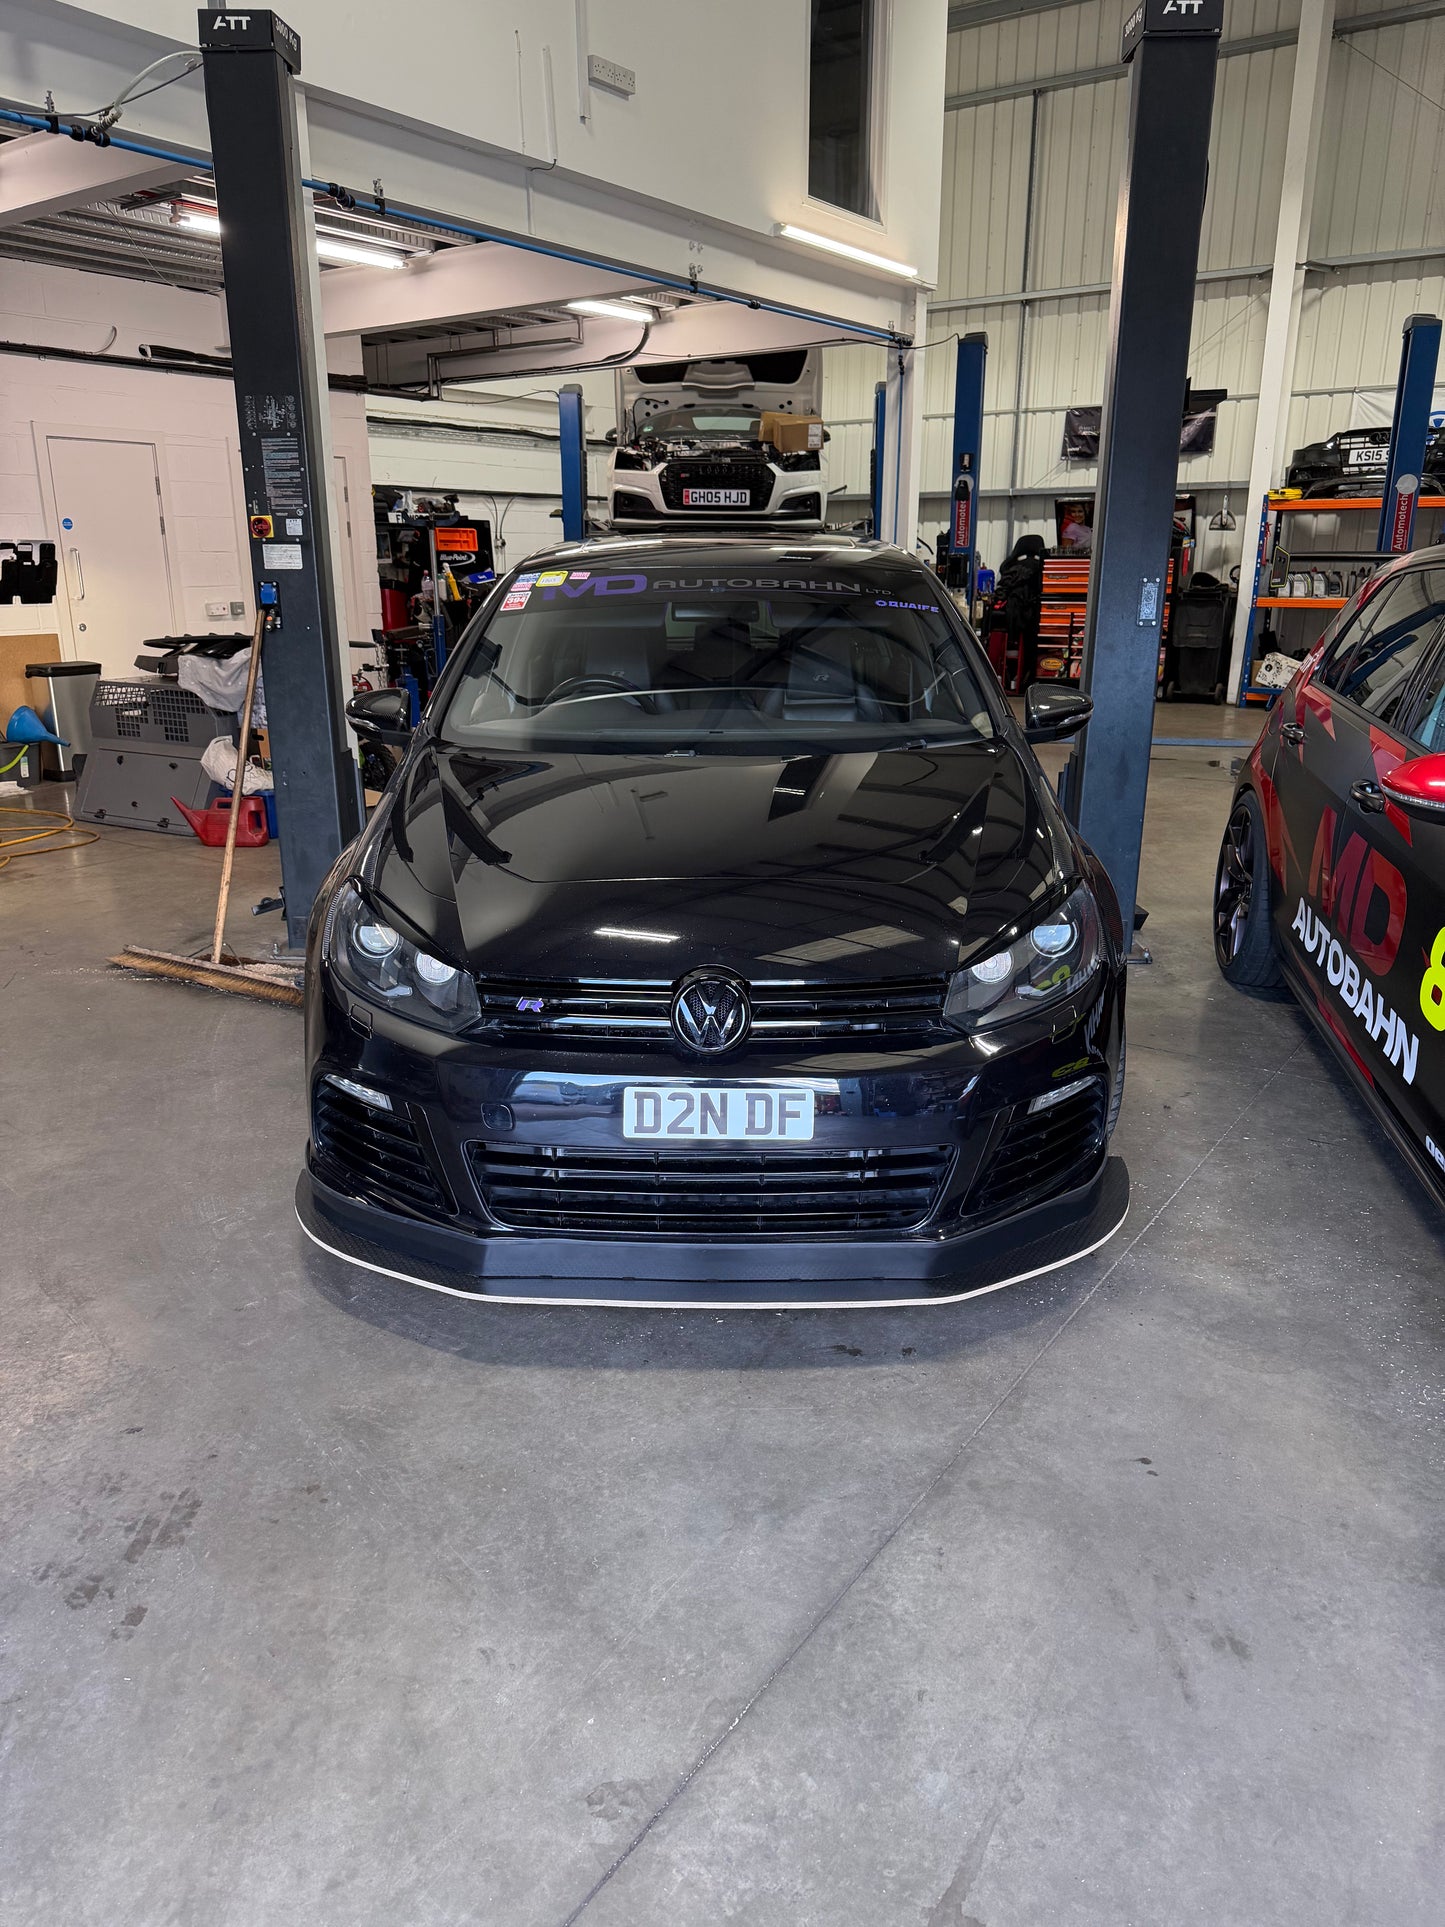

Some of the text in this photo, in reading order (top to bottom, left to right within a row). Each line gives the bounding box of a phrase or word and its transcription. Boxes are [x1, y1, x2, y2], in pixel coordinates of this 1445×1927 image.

[1162, 0, 1204, 14] ATT
[213, 15, 251, 30] ATT
[1356, 450, 1383, 462] KS15
[691, 491, 747, 503] GH05 HJD
[956, 500, 967, 546] Automotec
[1393, 494, 1409, 550] Automotech
[653, 578, 861, 593] AUTOBAHN
[888, 600, 939, 613] QUAIFE
[1308, 804, 1407, 977] MD
[1291, 896, 1420, 1086] AUTOBAHN
[634, 1091, 807, 1136] D2N DF
